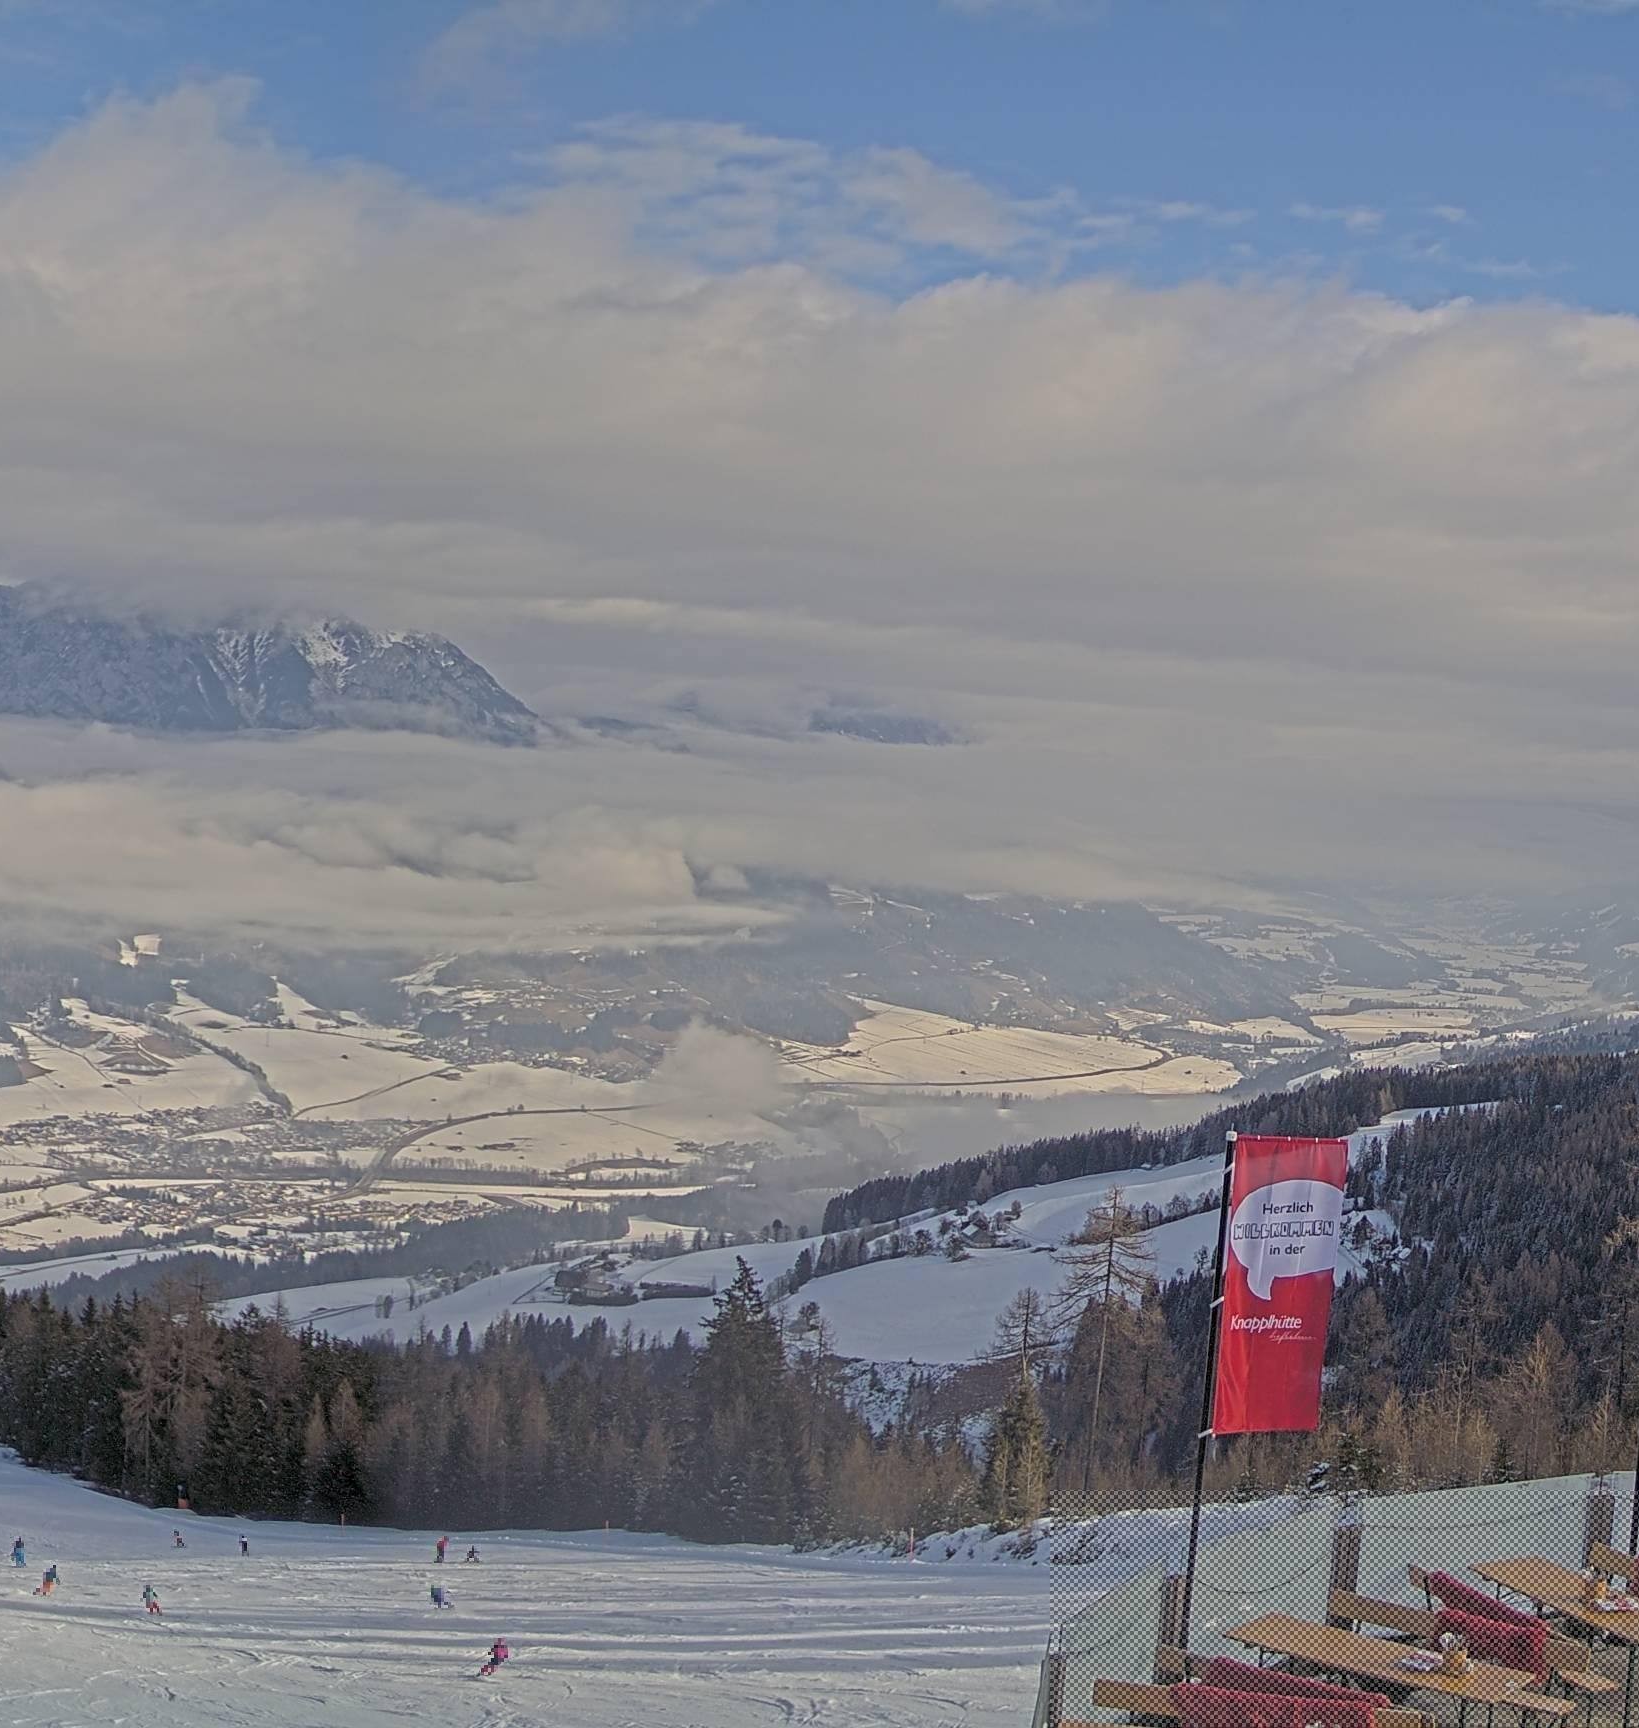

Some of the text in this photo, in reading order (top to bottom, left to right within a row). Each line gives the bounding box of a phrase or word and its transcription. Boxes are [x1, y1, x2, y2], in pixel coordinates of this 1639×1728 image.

[1262, 1202, 1313, 1215] Herzlich
[1233, 1220, 1334, 1240] WILLKOMMEN
[1270, 1243, 1306, 1255] in der
[1230, 1313, 1302, 1334] Knapplhütte
